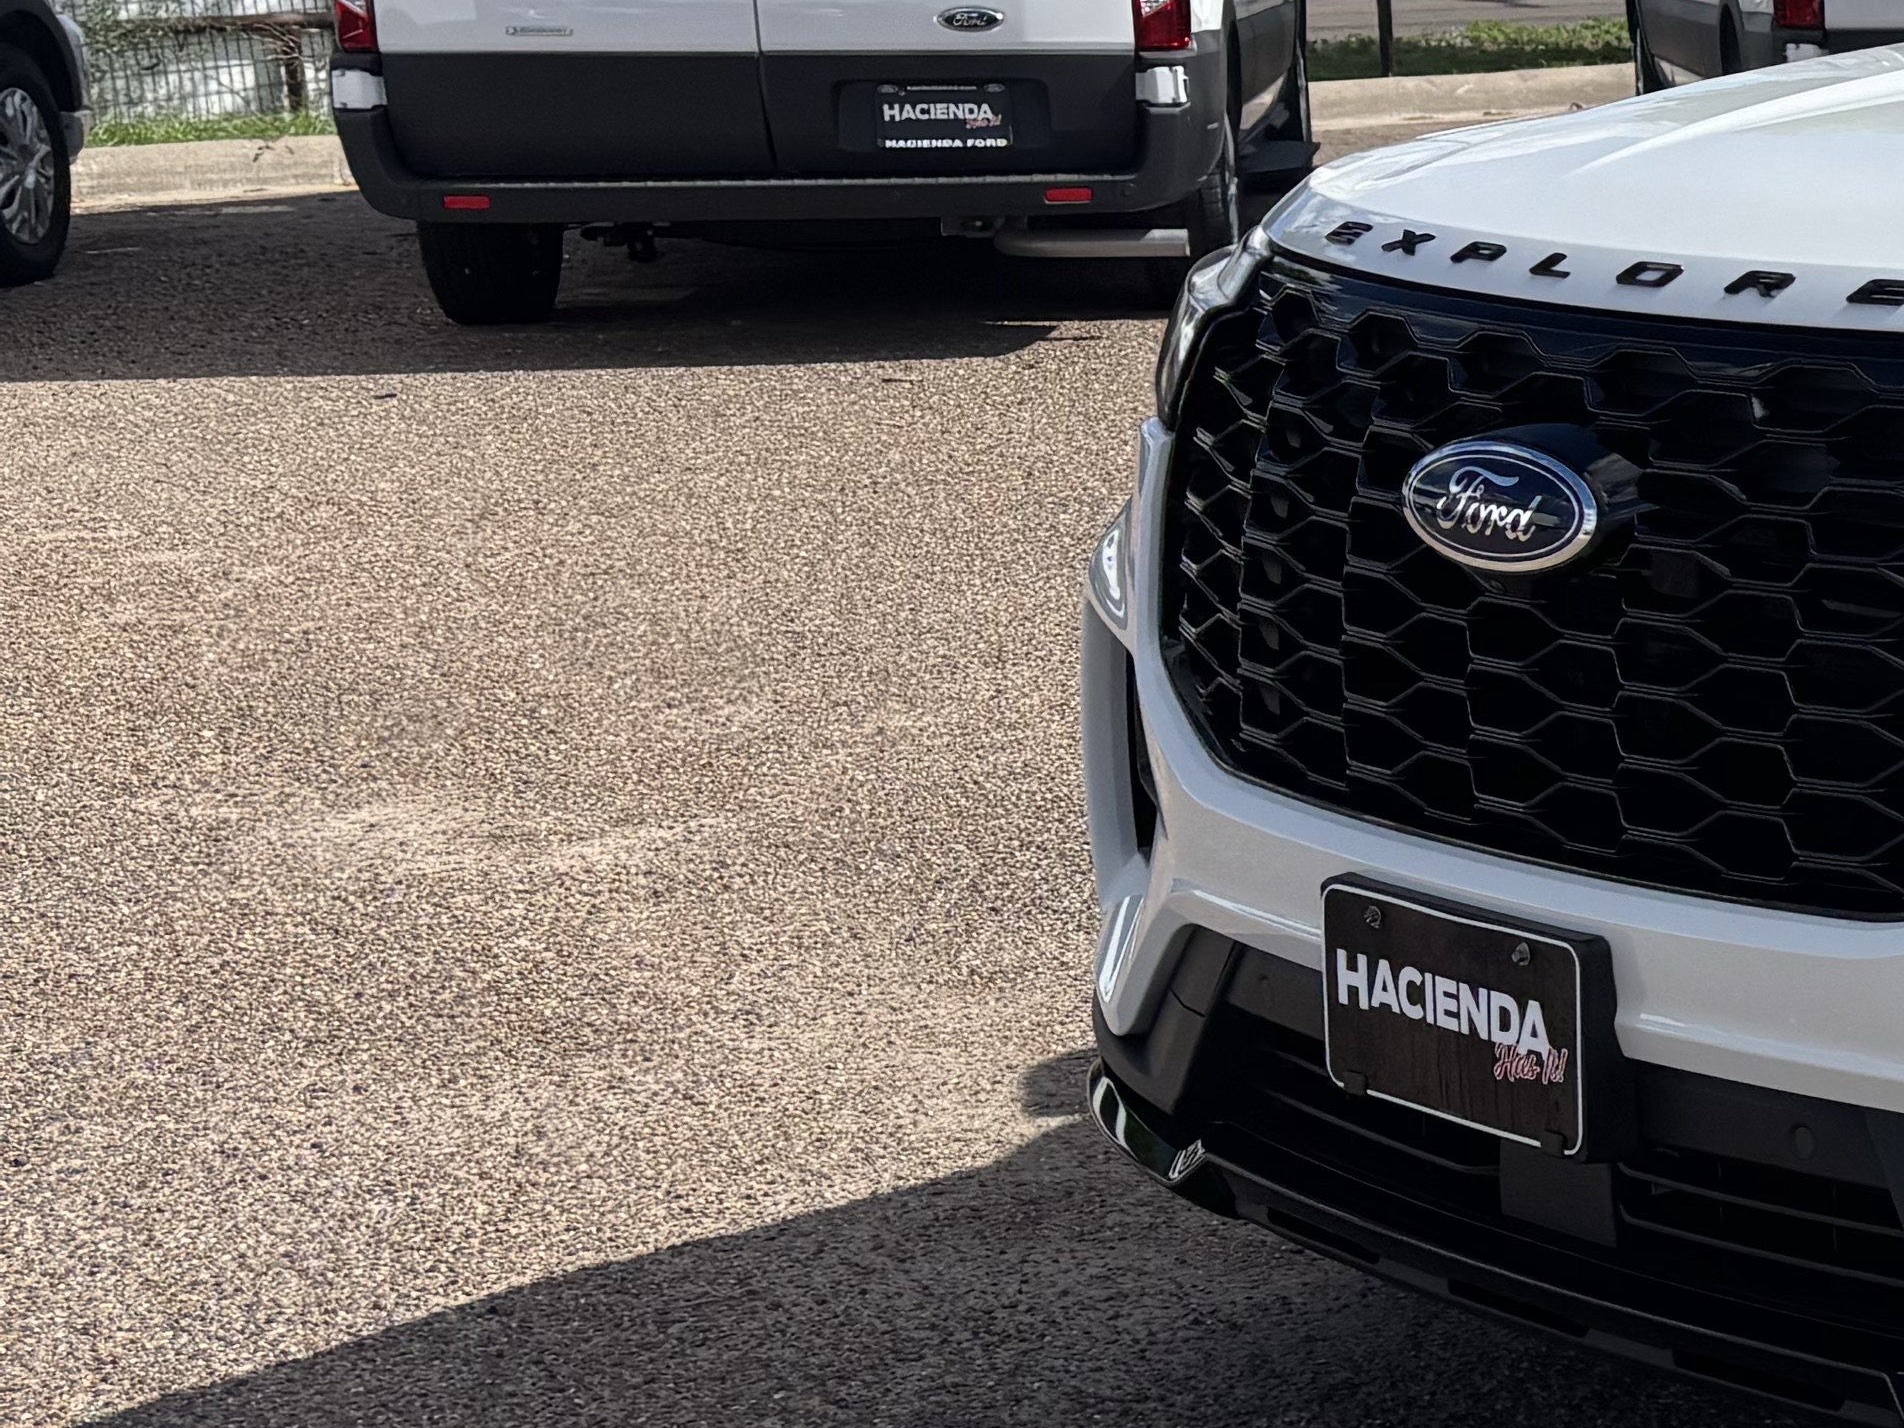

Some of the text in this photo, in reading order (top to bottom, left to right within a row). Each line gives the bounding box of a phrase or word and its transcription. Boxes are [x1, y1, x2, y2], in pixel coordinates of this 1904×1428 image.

[952, 12, 988, 27] Ford
[882, 103, 993, 122] HACIENDA
[885, 137, 1008, 149] HACIENDA FORD
[1435, 466, 1541, 543] Ford
[1336, 948, 1550, 1061] HACIENDA
